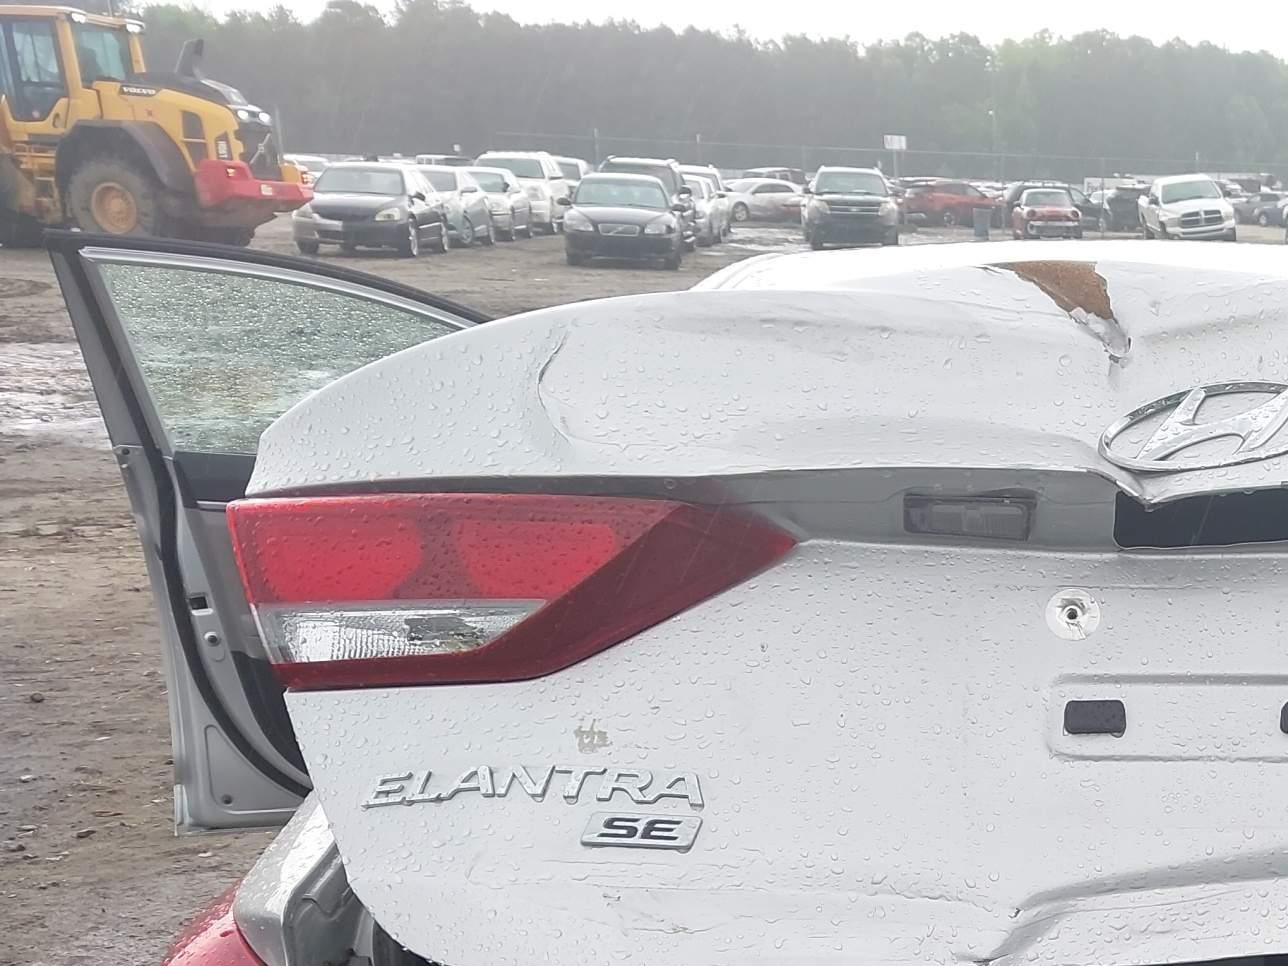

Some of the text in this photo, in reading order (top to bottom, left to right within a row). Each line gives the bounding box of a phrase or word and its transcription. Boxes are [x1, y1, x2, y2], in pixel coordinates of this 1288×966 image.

[122, 87, 156, 95] VOLVO
[362, 765, 704, 810] ELANTRA
[597, 817, 682, 841] SE
